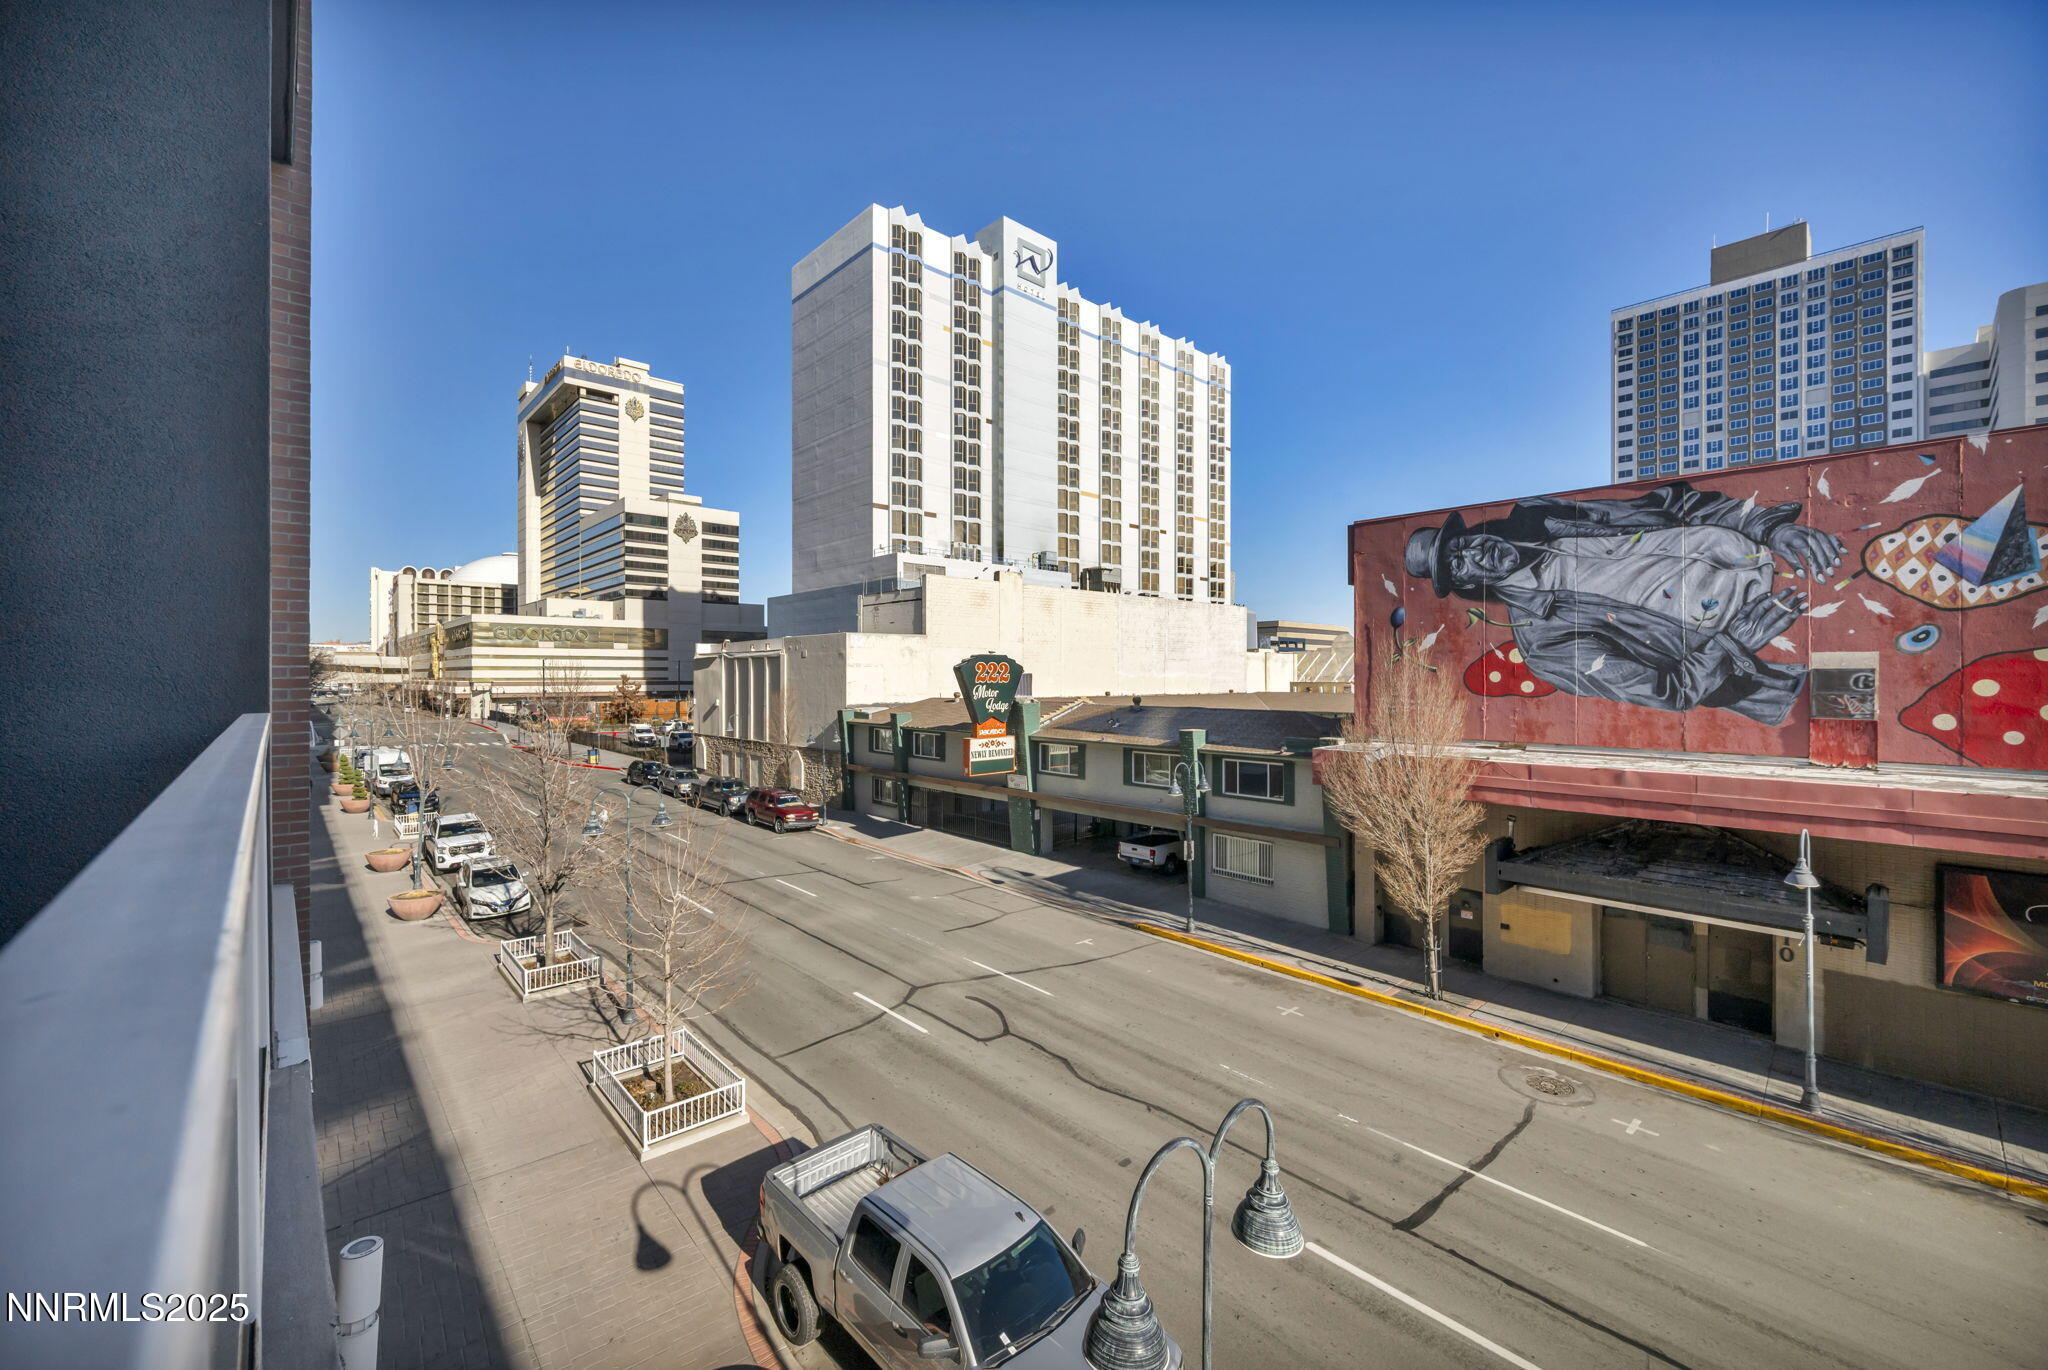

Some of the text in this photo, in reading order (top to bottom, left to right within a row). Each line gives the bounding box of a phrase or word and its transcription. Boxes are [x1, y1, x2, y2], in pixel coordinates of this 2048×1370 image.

[975, 661, 1010, 683] 222
[972, 684, 999, 700] Motor
[985, 698, 1009, 713] Lodge
[970, 749, 987, 759] NEWLY
